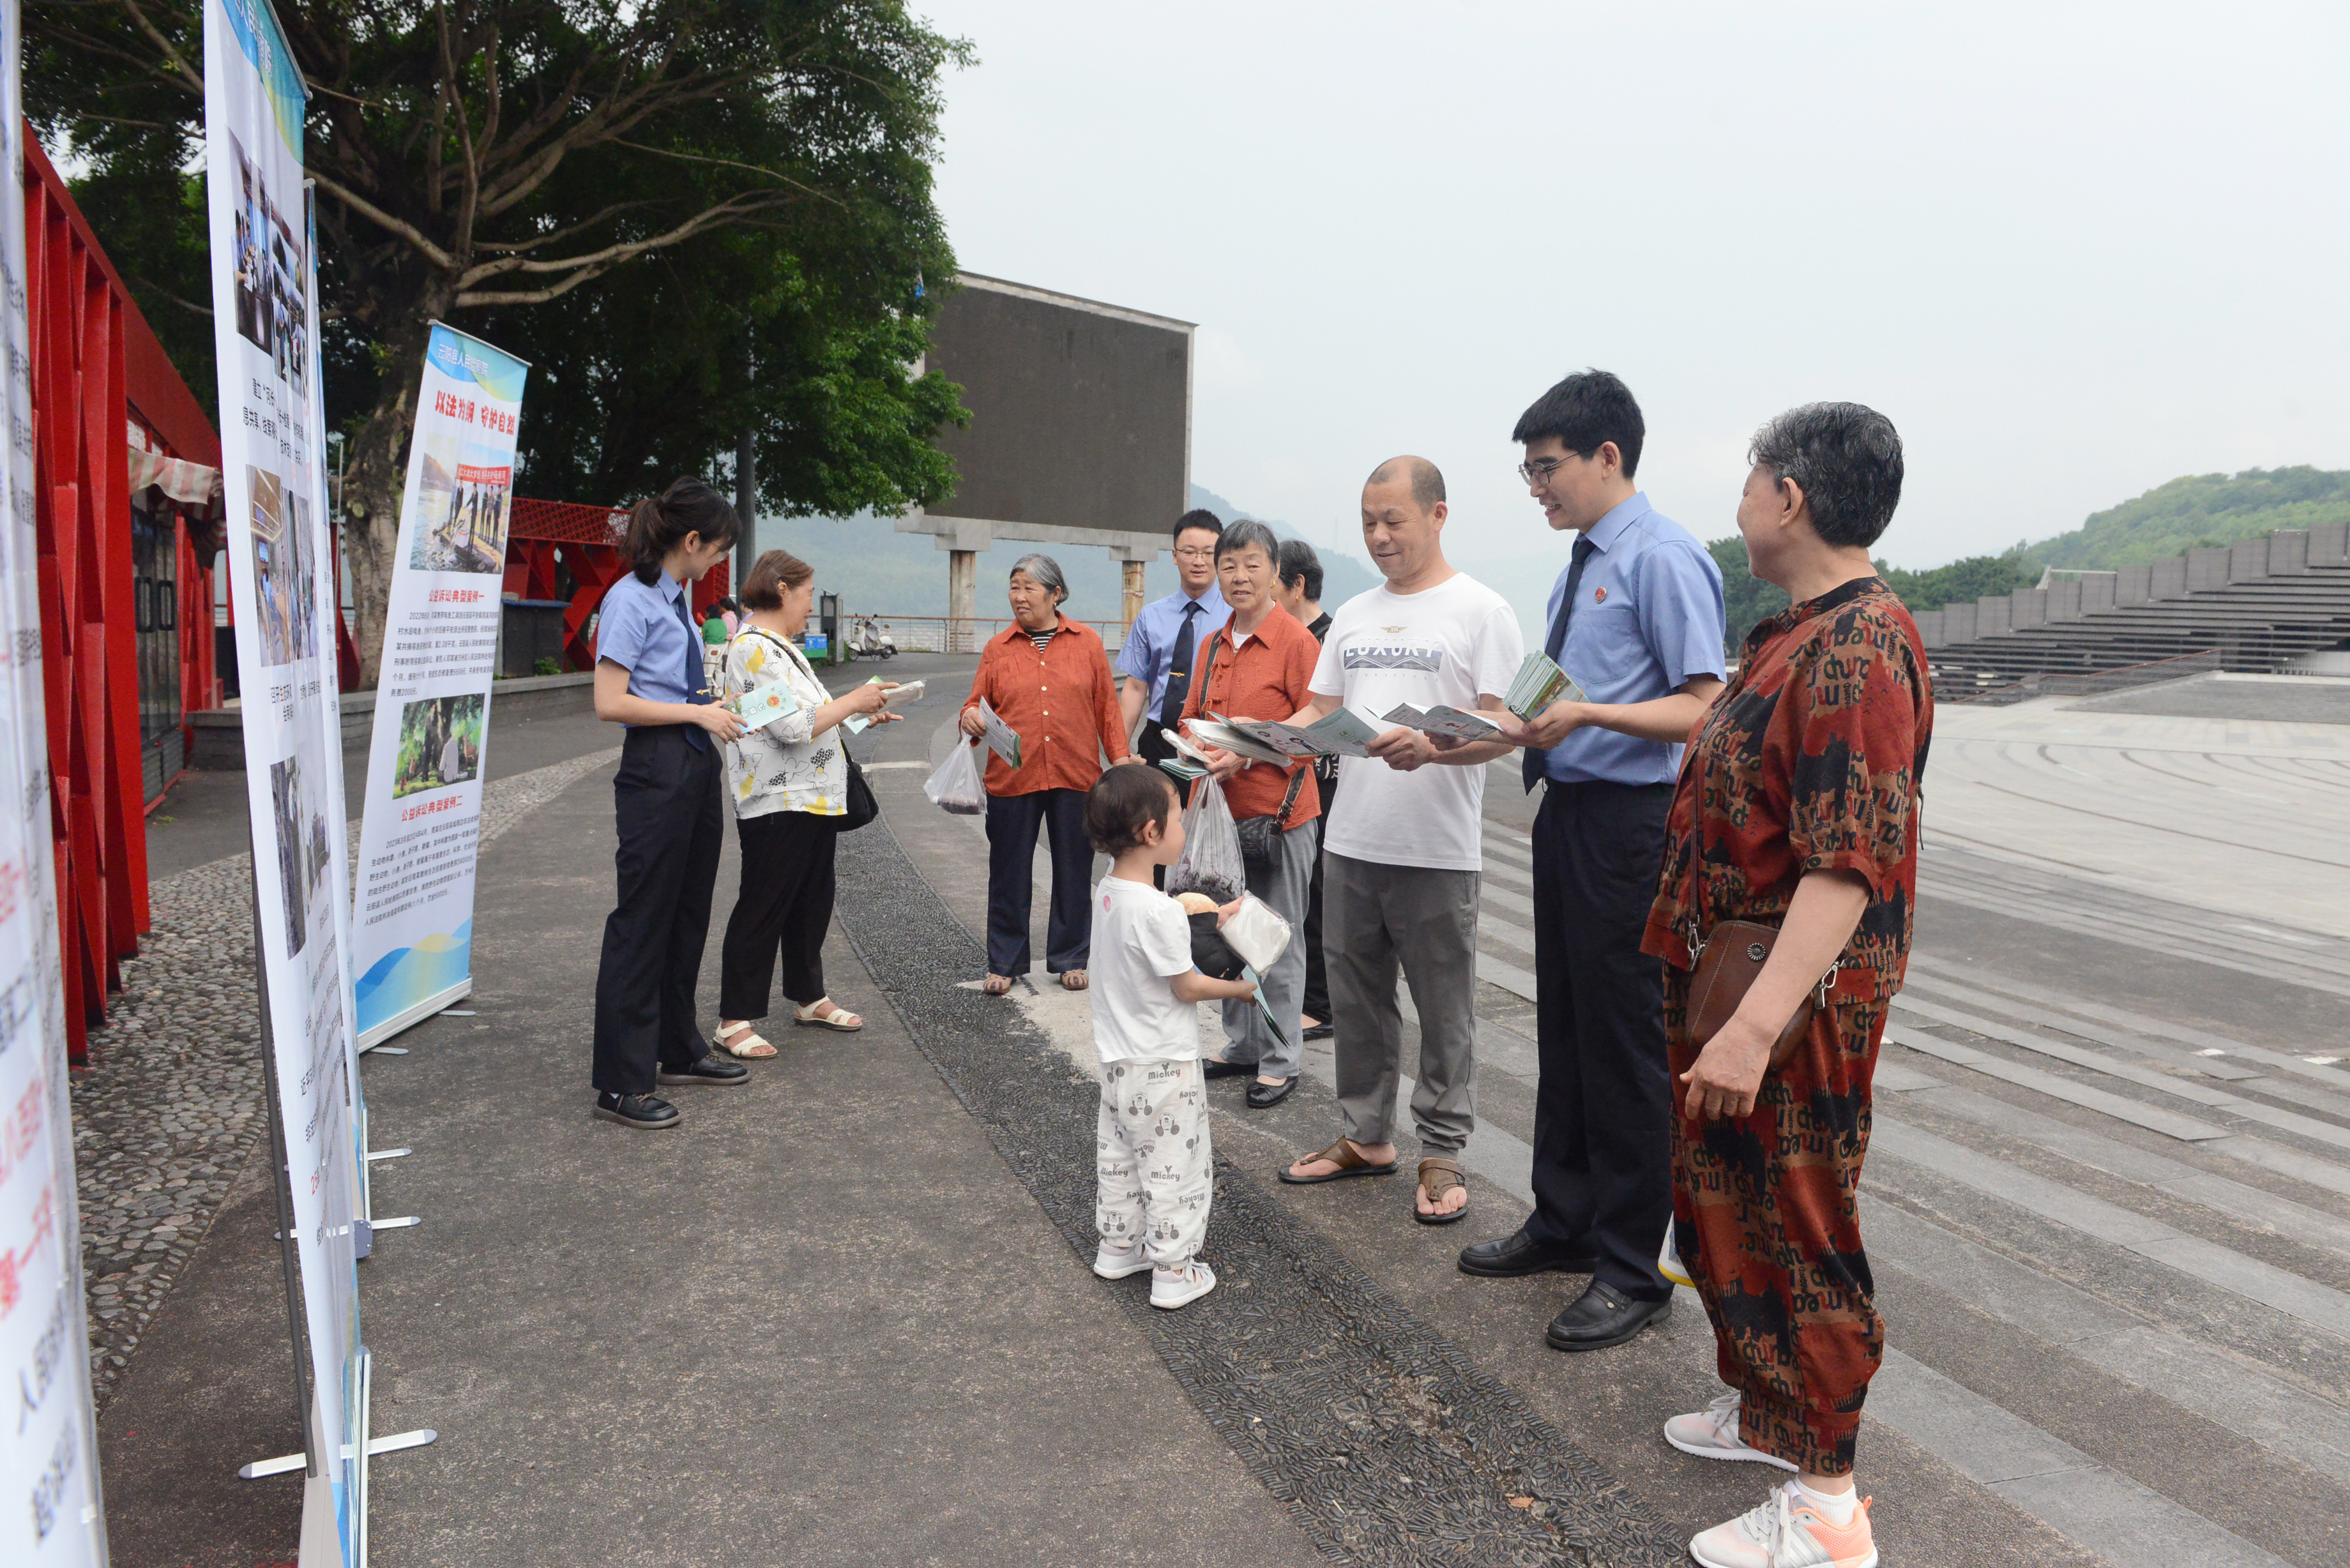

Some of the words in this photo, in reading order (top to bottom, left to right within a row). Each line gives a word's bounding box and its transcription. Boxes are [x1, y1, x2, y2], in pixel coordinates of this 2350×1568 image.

[437, 343, 489, 377] 云阳县人民检察院
[435, 390, 475, 424] 以法为纲
[481, 405, 515, 435] 守护自然
[428, 589, 485, 603] 公益诉讼典型案例一
[1346, 639, 1440, 658] LUXURY
[401, 795, 463, 822] 公益诉讼典型案例二
[1148, 1066, 1181, 1080] Mickey
[1179, 1090, 1198, 1102] ickey
[1100, 1165, 1128, 1178] Mickey
[1151, 1168, 1181, 1182] Mickey
[1179, 1192, 1205, 1207] Mickey
